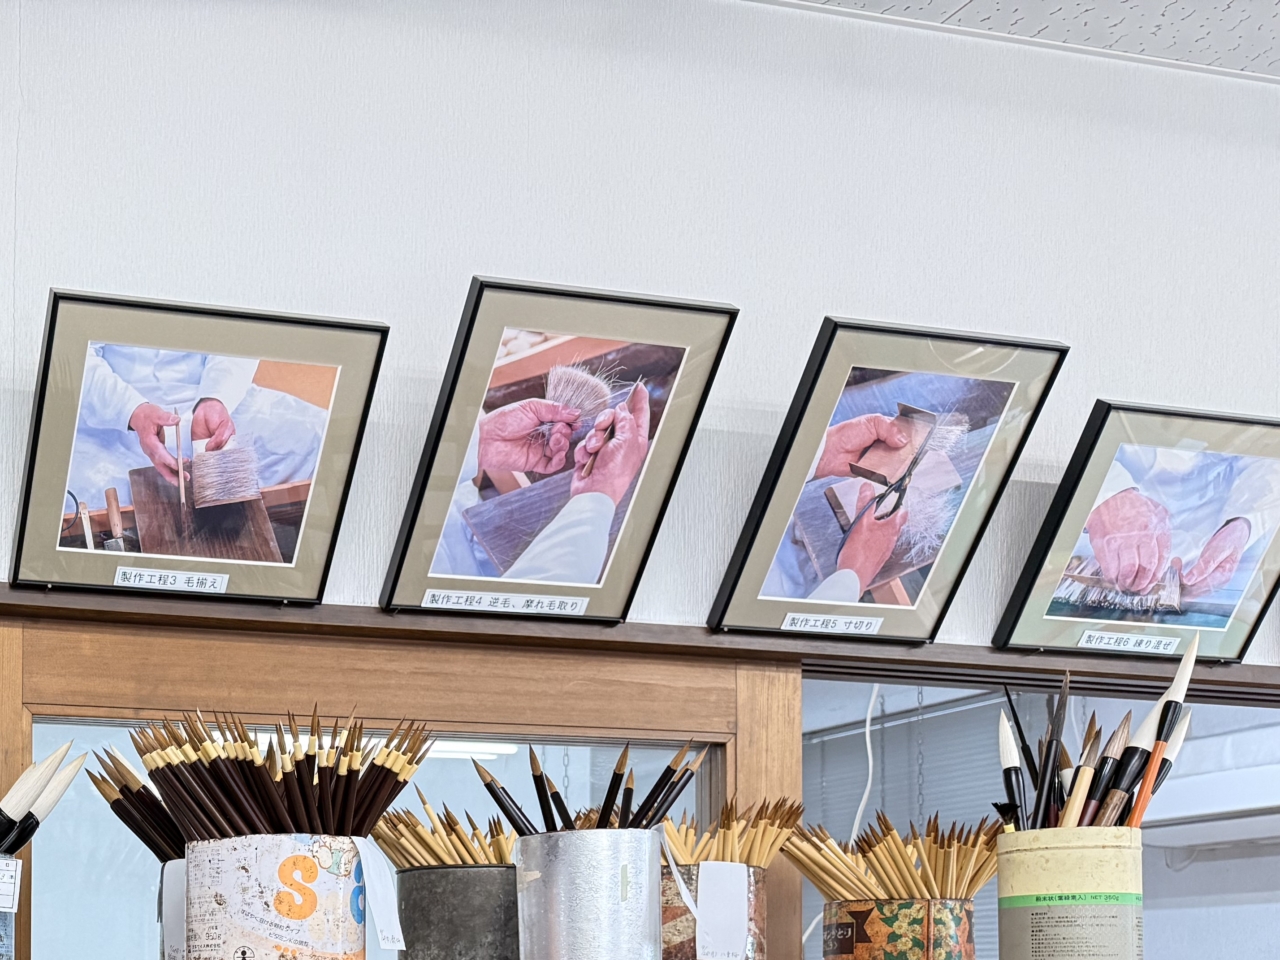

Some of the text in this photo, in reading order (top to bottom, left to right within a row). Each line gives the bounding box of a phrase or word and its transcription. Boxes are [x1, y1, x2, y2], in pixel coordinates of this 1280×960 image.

[121, 571, 218, 589] 製作工程3 毛揃え
[429, 593, 482, 605] 製作工程4
[789, 617, 872, 630] 製作工程5 寸切り
[1085, 634, 1130, 647] 製作工程6
